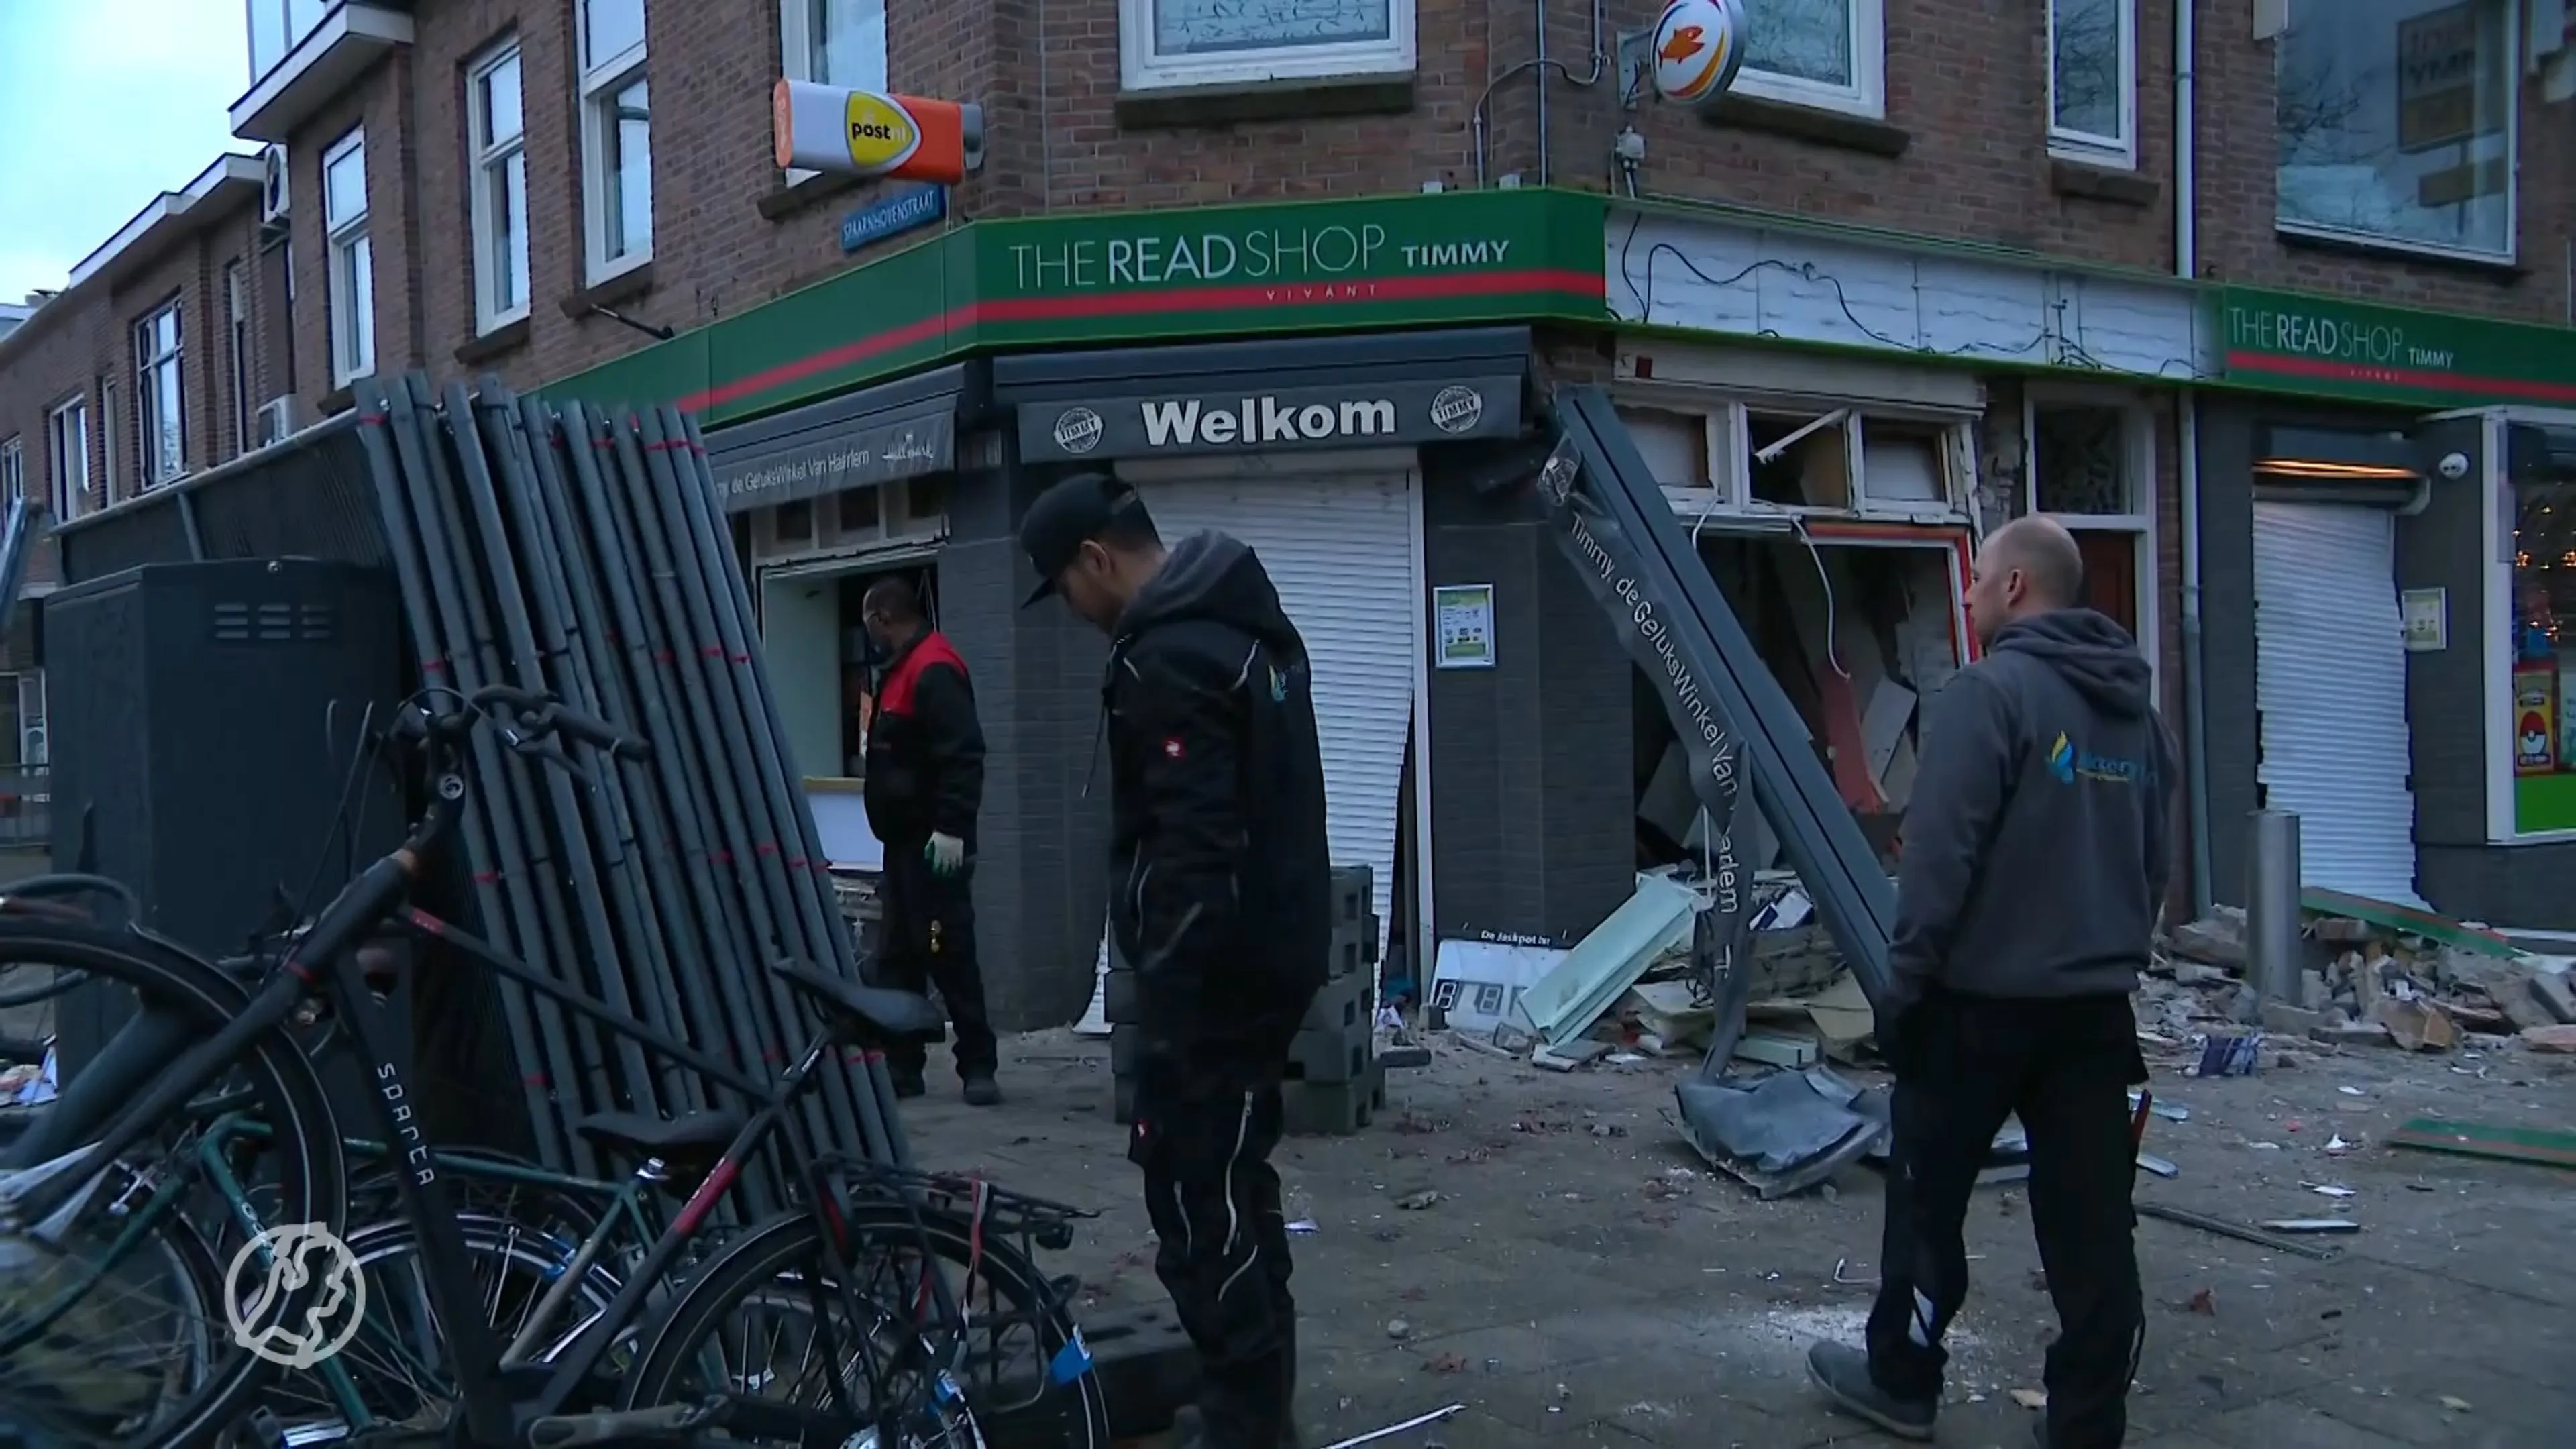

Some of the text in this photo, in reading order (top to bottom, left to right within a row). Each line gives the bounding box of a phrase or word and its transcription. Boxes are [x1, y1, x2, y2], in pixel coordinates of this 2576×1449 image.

[1010, 224, 1511, 290] THE READ SHOP TIMMY
[1267, 284, 1378, 301] VIVANT
[2229, 307, 2454, 369] THE READ SHOP TIMMY
[1141, 396, 1396, 445] Welkom
[808, 456, 827, 477] Van
[827, 450, 870, 473] Haarlem
[1615, 578, 1639, 607] de
[1634, 601, 1726, 747] GeluksWinkel
[1711, 743, 1738, 796] Van
[1481, 930, 1496, 940] De
[1497, 932, 1537, 947] Jackpot
[377, 1062, 435, 1185] SPARTA
